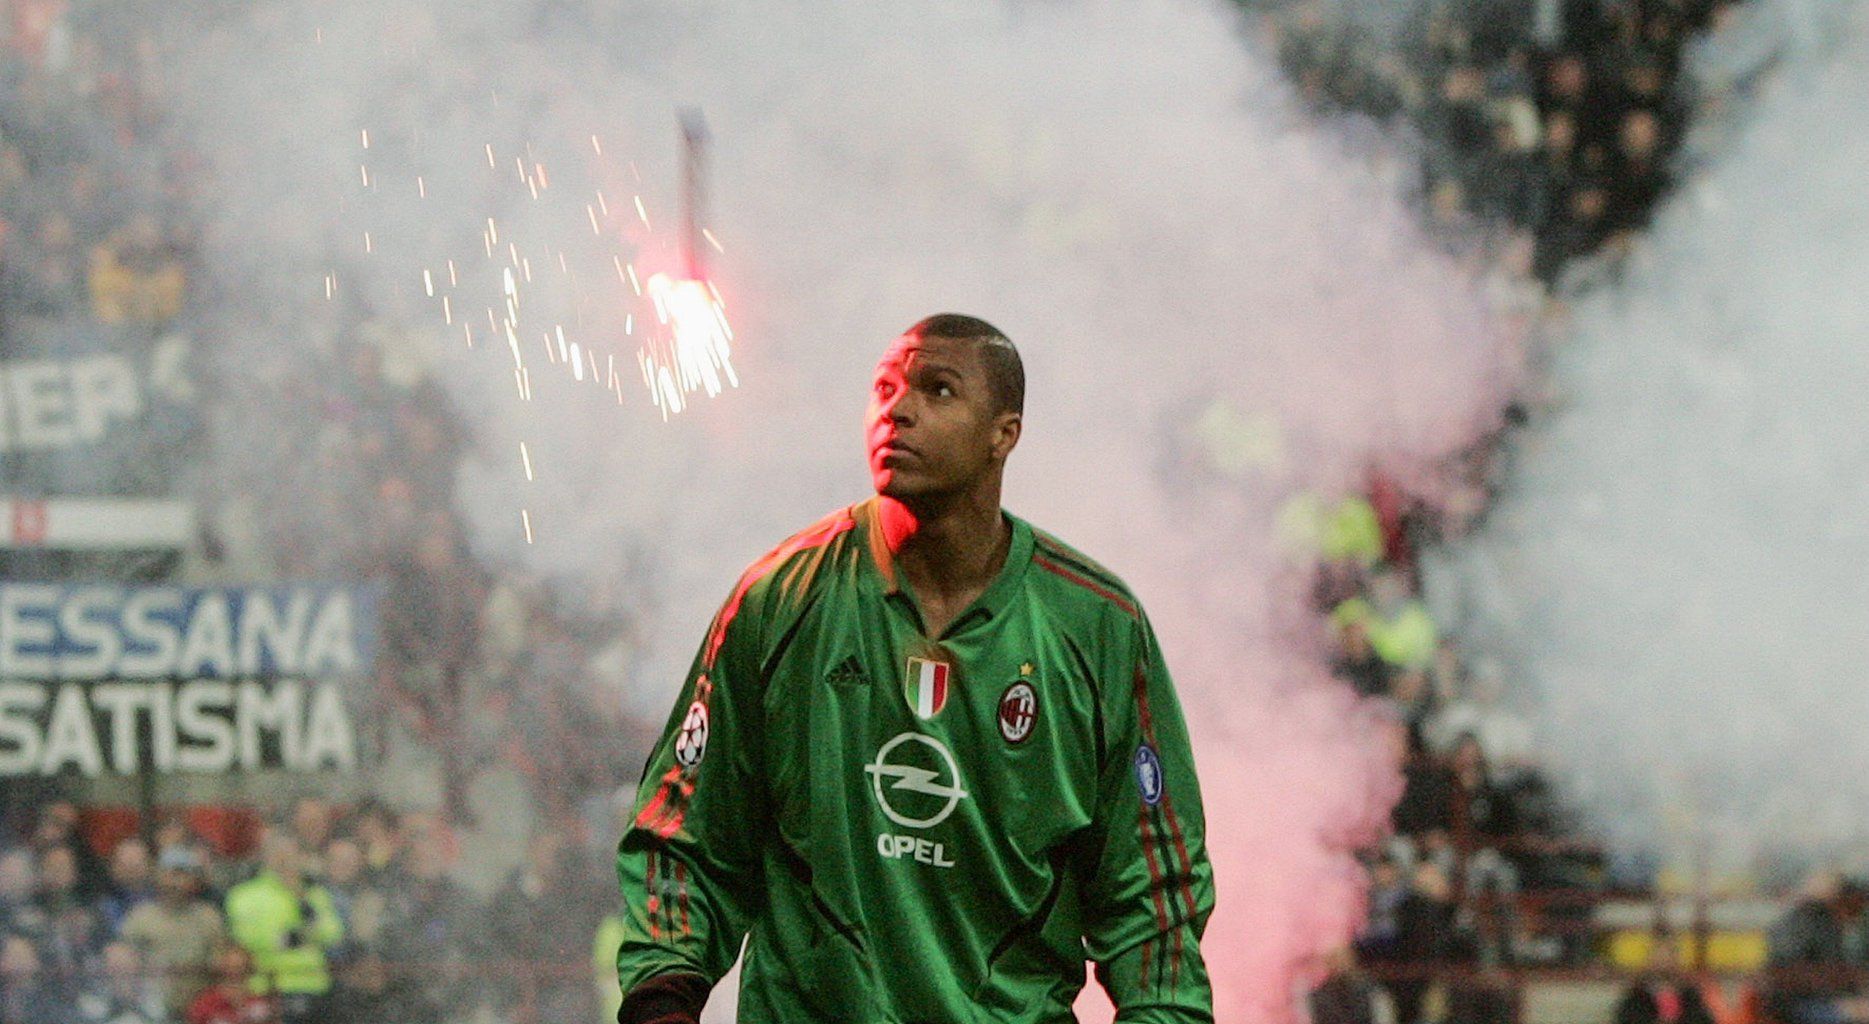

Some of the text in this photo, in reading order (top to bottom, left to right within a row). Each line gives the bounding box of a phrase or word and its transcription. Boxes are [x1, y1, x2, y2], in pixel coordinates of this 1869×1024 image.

[0, 585, 356, 677] ESSANA
[0, 682, 353, 774] SATISMA
[877, 832, 956, 868] OPEL
